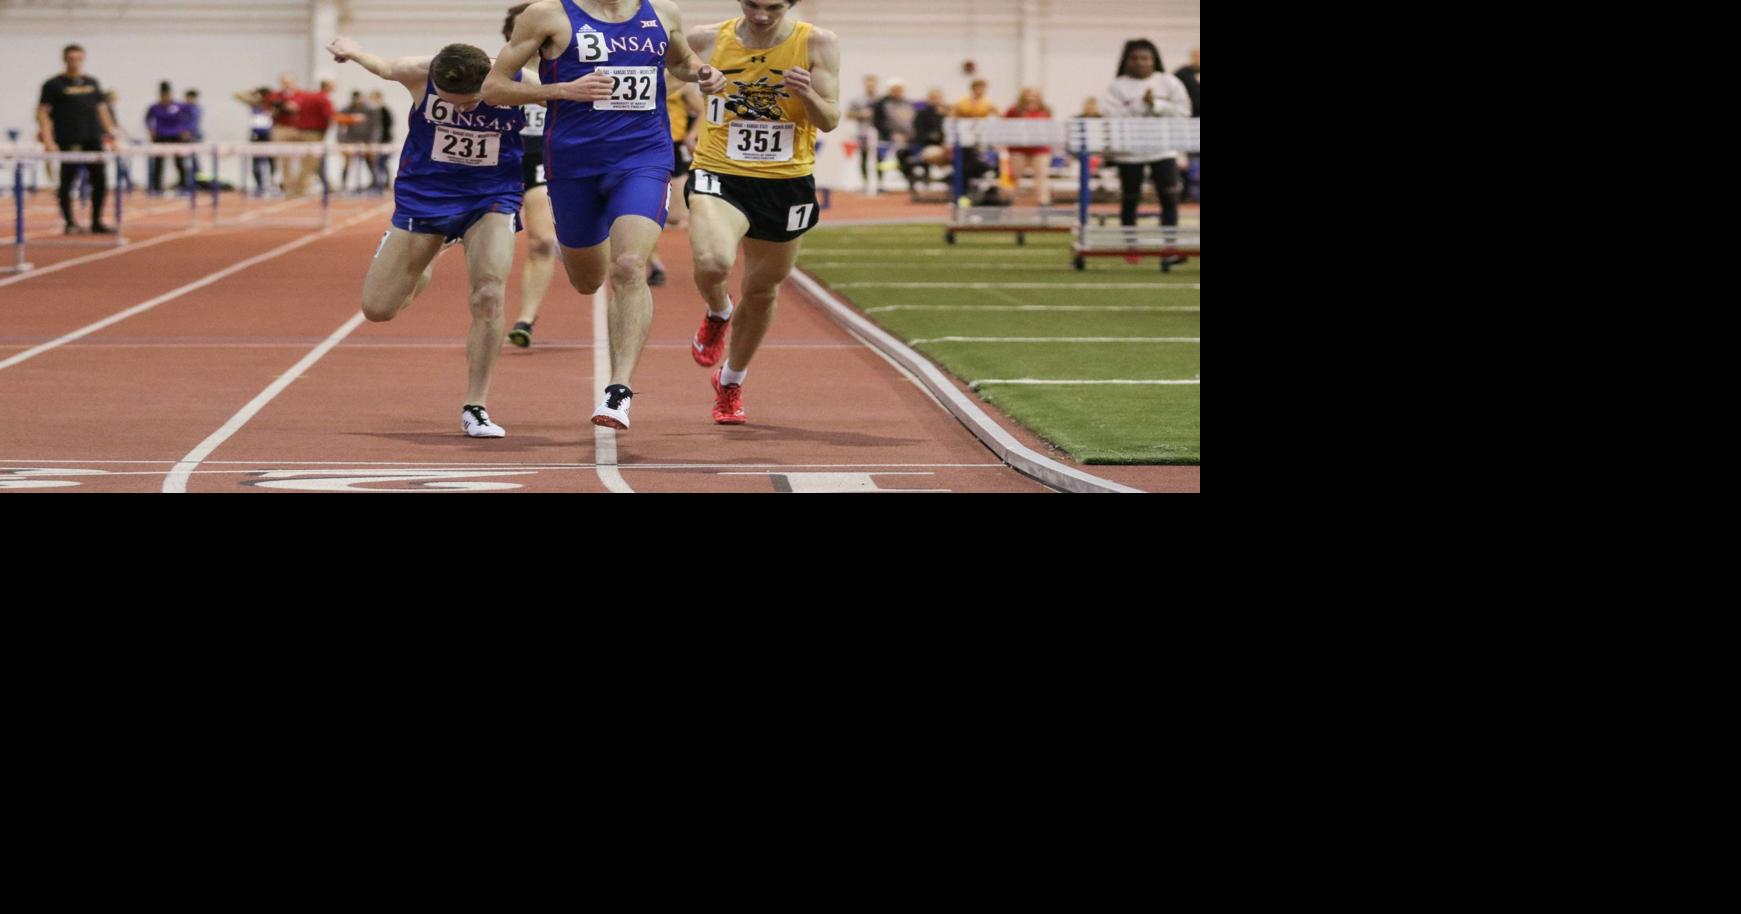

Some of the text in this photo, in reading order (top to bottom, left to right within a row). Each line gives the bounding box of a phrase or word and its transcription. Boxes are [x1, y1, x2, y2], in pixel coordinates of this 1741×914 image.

[583, 33, 602, 60] 3
[605, 35, 667, 56] NSAS
[610, 75, 651, 101] 232
[431, 98, 448, 121] 6
[711, 97, 719, 122] 1
[441, 134, 488, 159] 231
[737, 128, 782, 153] 351
[795, 205, 809, 228] 1
